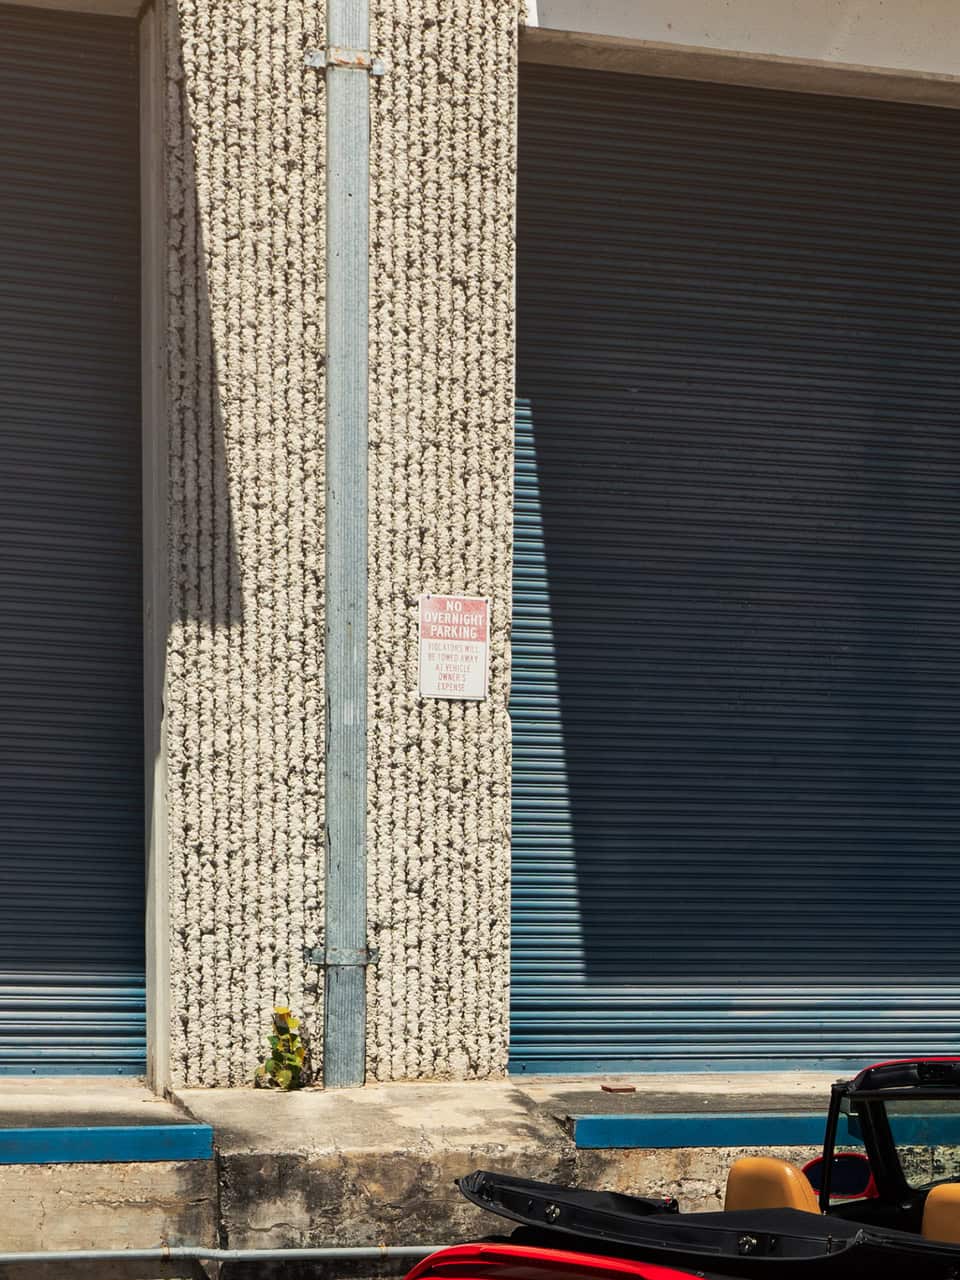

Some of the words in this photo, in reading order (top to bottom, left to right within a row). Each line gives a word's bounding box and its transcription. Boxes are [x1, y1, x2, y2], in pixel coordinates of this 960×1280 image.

[446, 601, 462, 612] NO
[424, 612, 484, 626] OVERNIGHT
[430, 625, 477, 639] PARKING
[438, 654, 459, 662] TOWED
[460, 655, 480, 664] AWAY
[435, 663, 444, 672] AT
[446, 664, 472, 673] VEHICLE
[437, 682, 465, 692] EXPENSE
